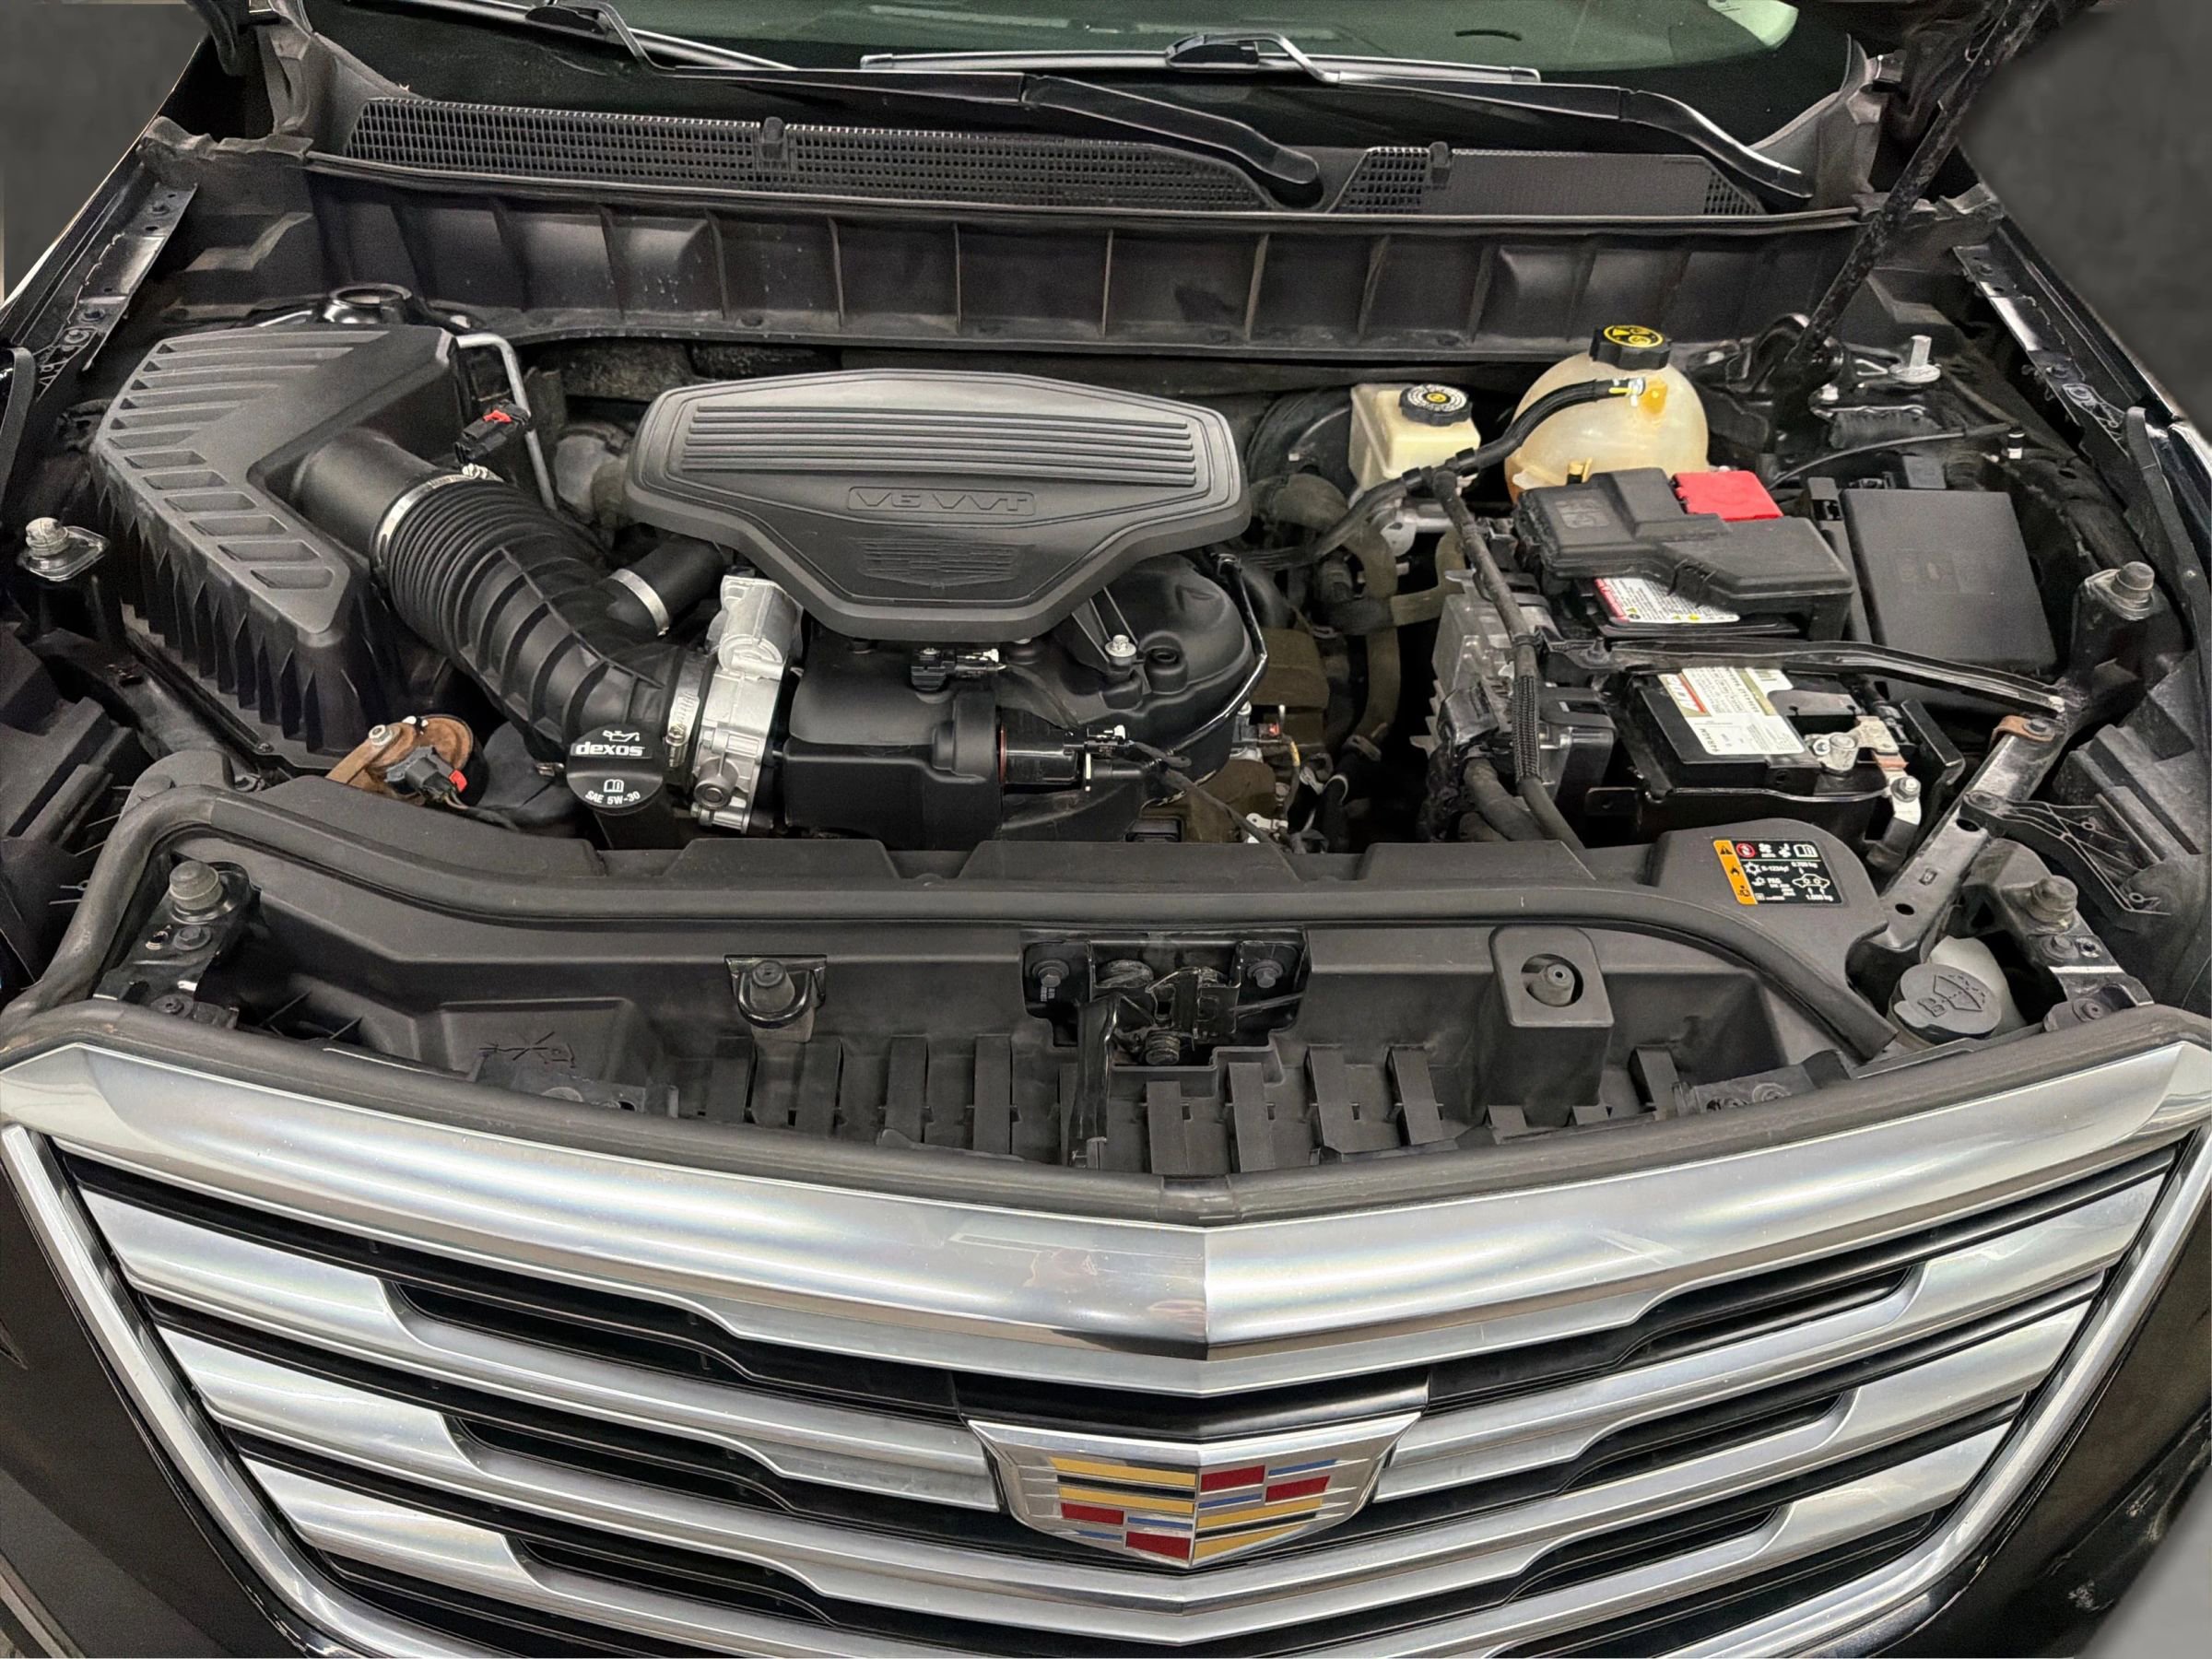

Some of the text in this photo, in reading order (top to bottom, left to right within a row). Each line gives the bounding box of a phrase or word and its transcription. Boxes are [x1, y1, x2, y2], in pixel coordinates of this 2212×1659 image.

[856, 492, 1028, 512] V6 VVT
[575, 741, 645, 757] dexos
[584, 790, 641, 805] SAE 5W-30
